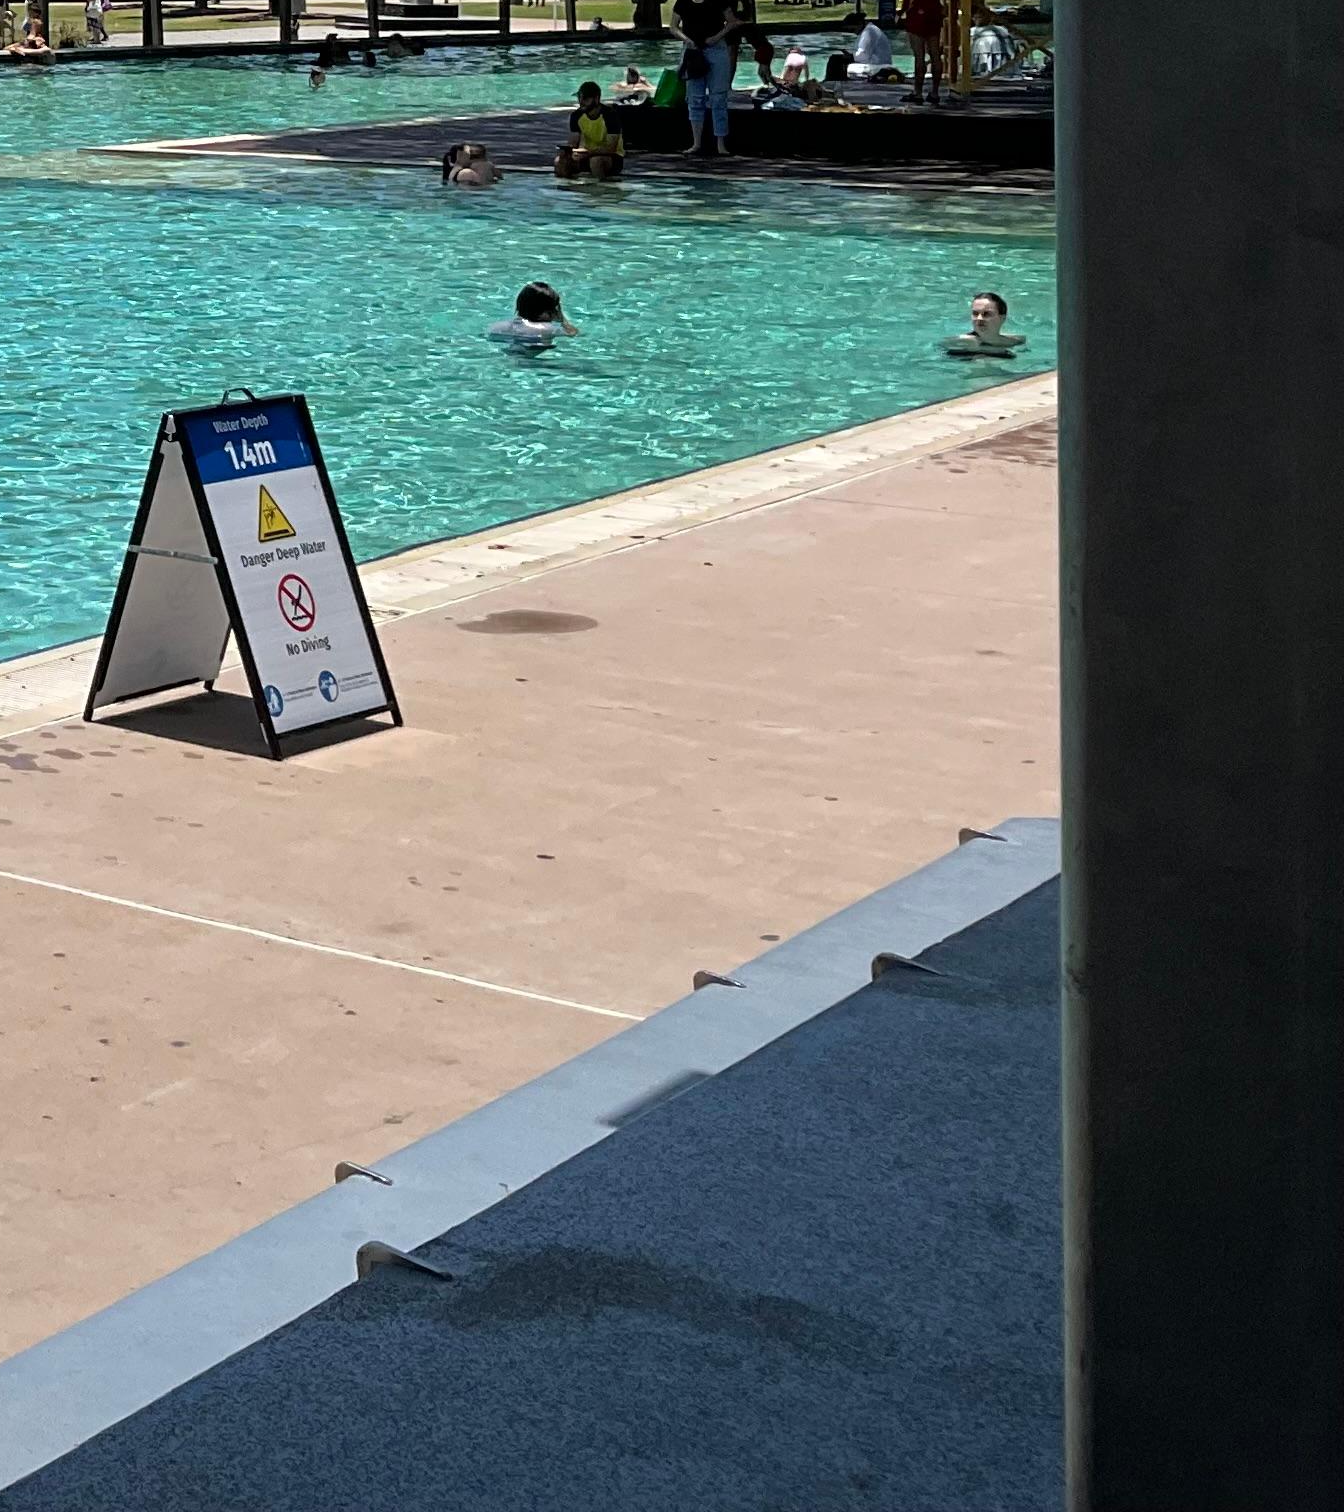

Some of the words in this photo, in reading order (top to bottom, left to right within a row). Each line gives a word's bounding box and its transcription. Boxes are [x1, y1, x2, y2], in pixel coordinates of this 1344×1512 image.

[212, 419, 241, 434] Water
[241, 413, 269, 430] Depth
[224, 438, 277, 470] 1.4m
[240, 551, 274, 568] Danger
[275, 546, 300, 561] Deep
[300, 541, 326, 555] Water
[286, 643, 300, 656] No
[301, 635, 331, 653] Diving
